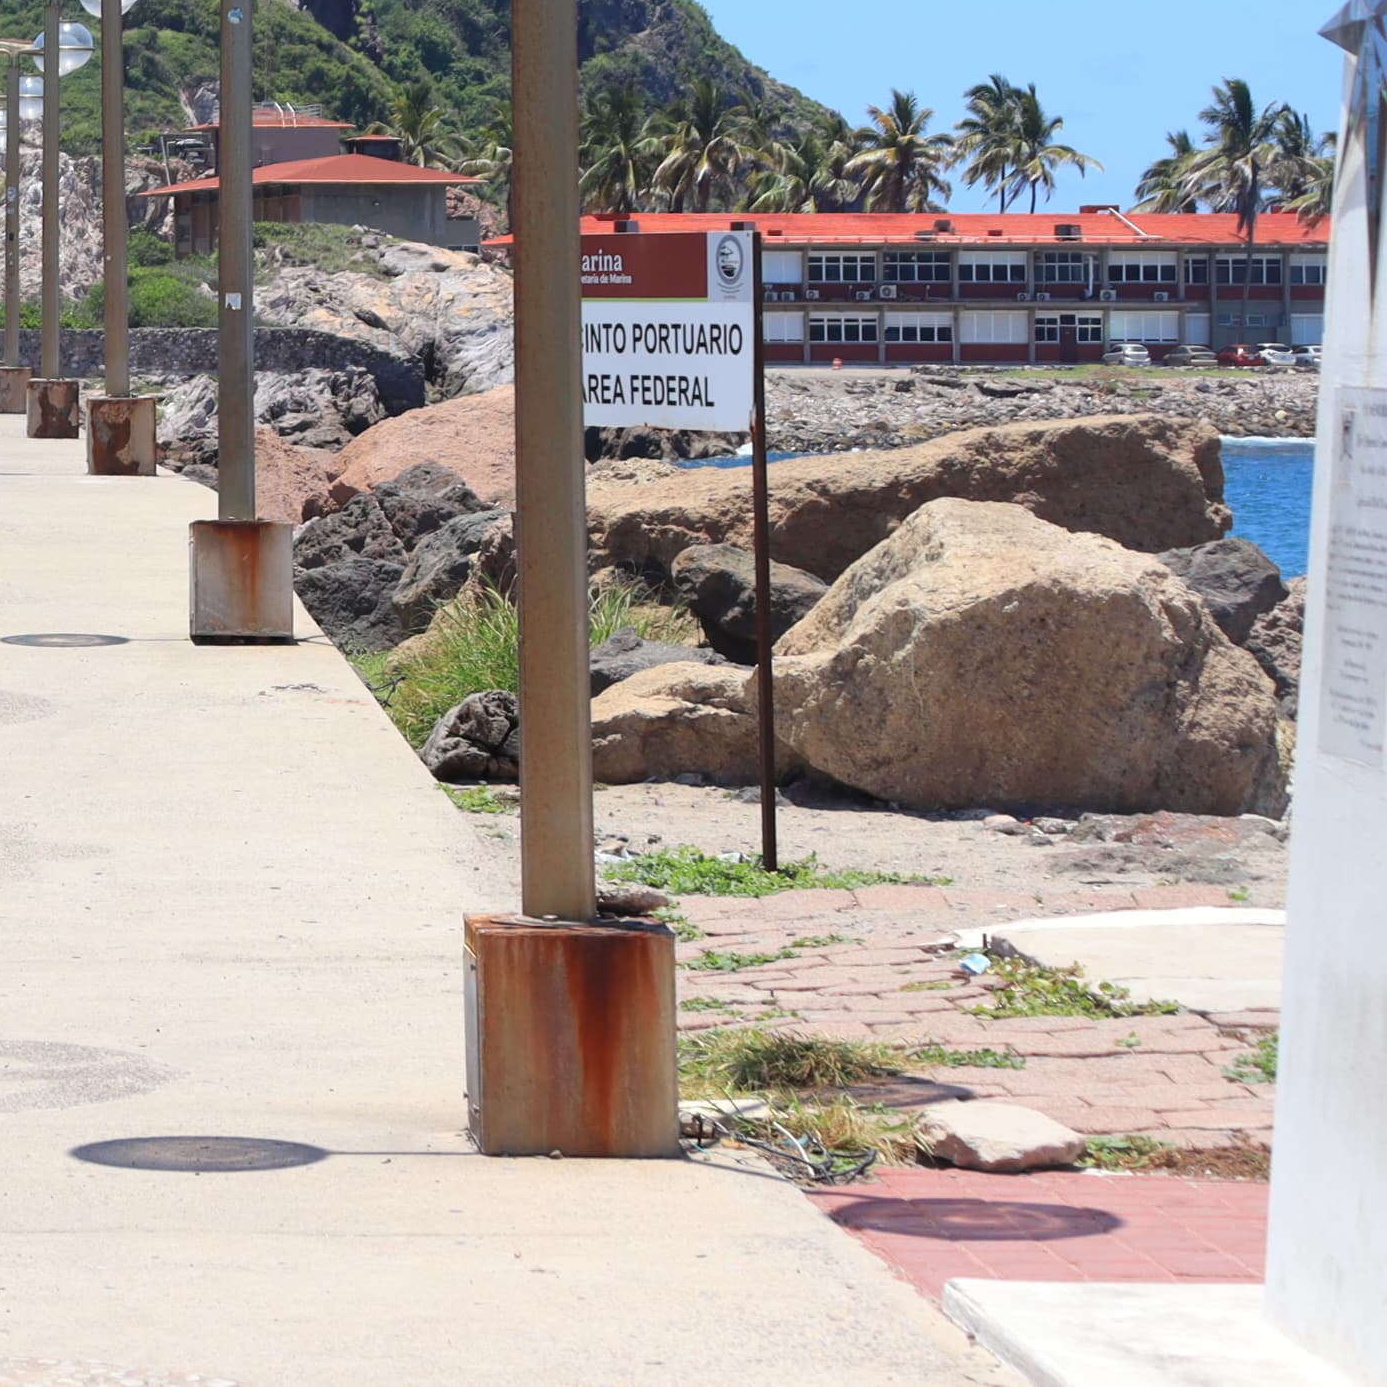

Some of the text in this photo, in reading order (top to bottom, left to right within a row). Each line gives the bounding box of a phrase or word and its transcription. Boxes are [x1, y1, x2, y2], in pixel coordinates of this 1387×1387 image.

[581, 323, 743, 356] INTO PORTUARIO
[630, 374, 715, 407] FEDERAL
